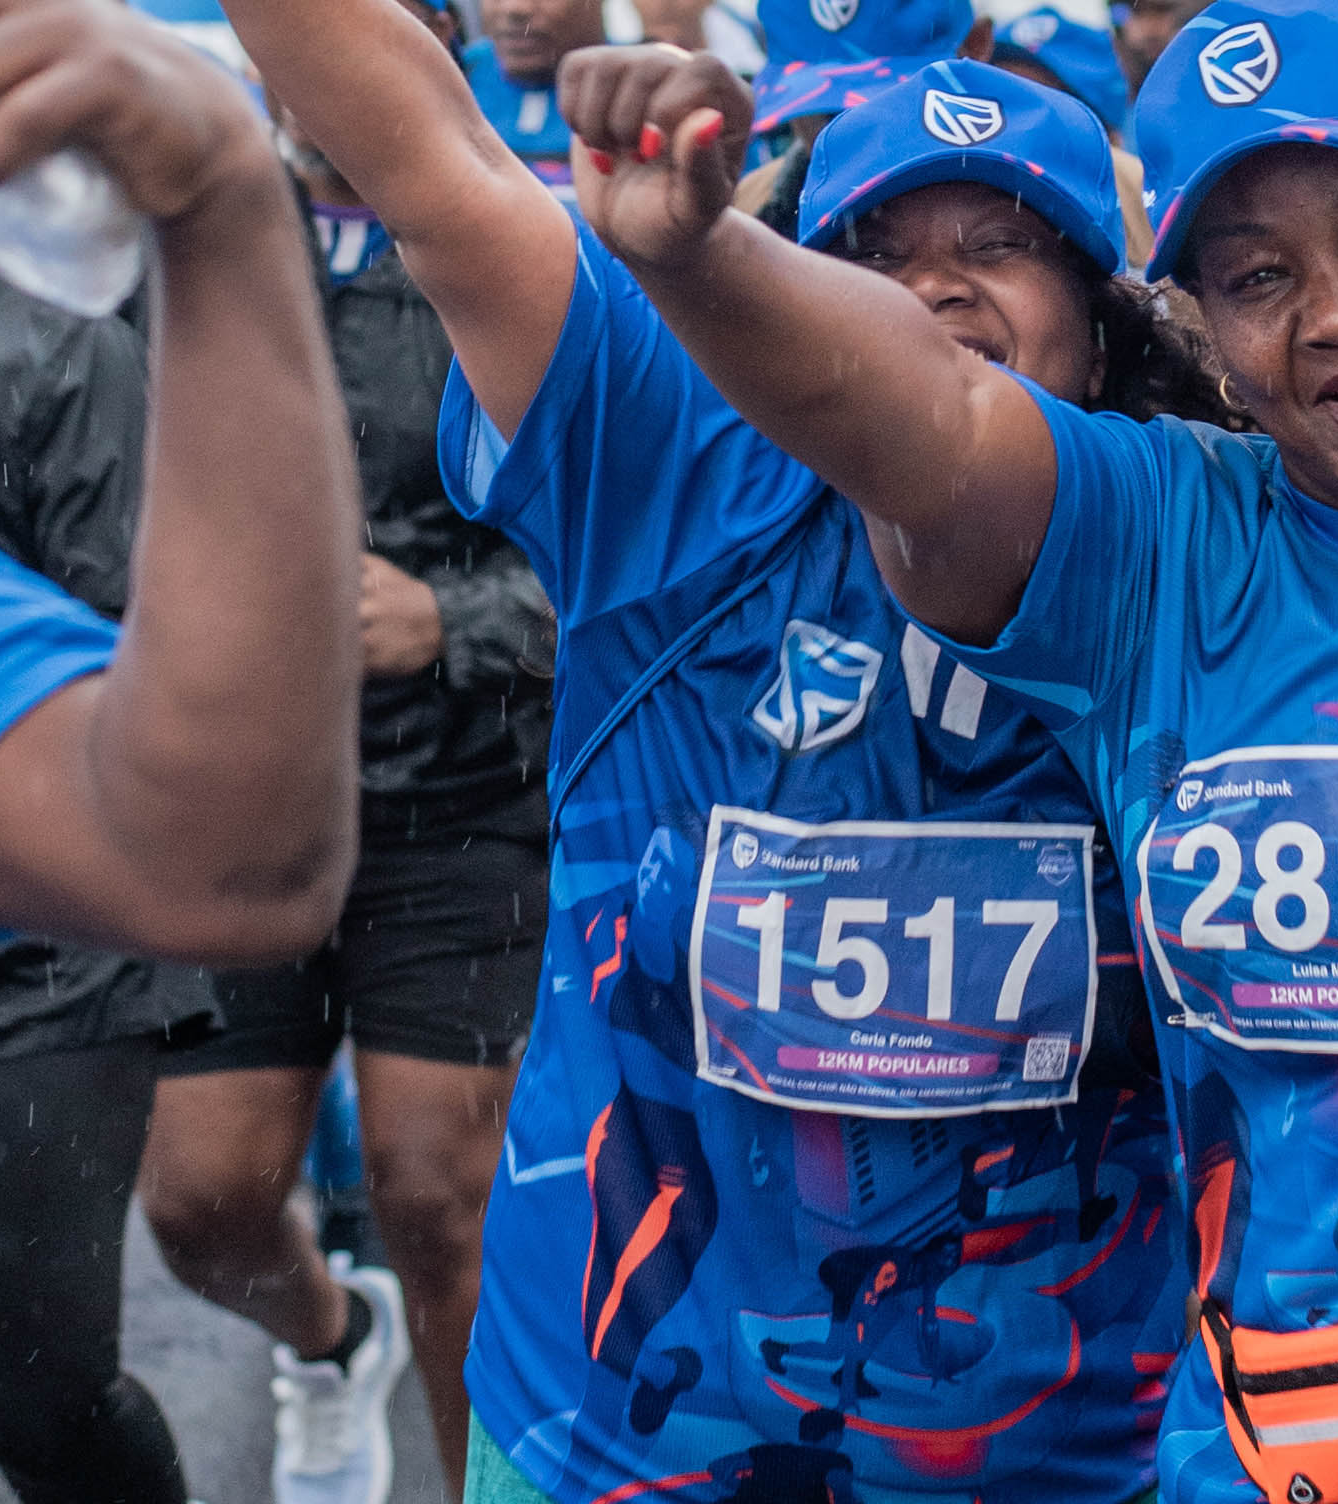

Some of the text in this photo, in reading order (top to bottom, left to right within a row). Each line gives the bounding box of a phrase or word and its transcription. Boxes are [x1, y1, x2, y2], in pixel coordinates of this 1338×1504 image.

[1255, 778, 1293, 797] Bank
[822, 853, 861, 872] Bank
[736, 890, 1060, 1022] 1517
[1269, 986, 1314, 1005] 12KM
[817, 1050, 970, 1075] 12KM POPULARES
